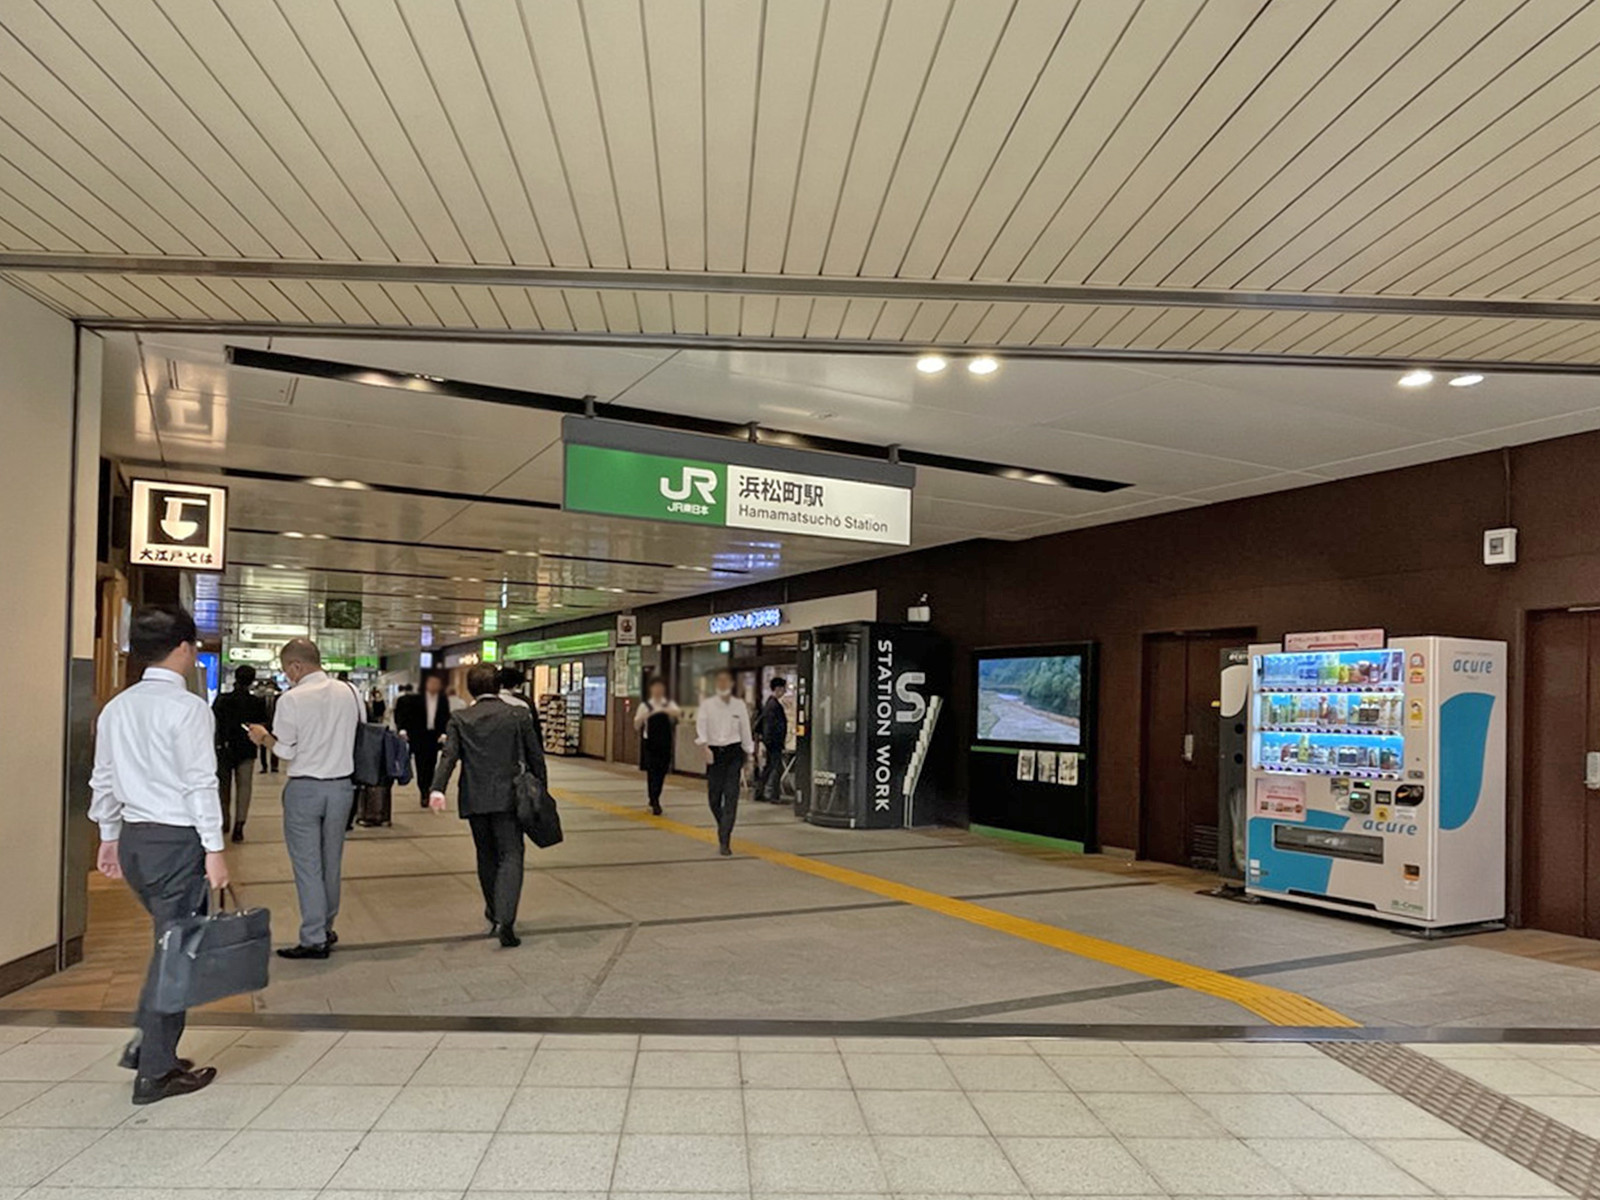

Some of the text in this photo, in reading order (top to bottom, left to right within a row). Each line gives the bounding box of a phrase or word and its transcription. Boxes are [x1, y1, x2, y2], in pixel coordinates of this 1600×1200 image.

[660, 466, 717, 504] JR
[738, 475, 823, 507] 浜松町駅
[667, 501, 709, 516] JR東日本
[844, 515, 888, 533] Station
[1452, 658, 1493, 675] acure
[875, 639, 893, 812] STATION WORK
[1362, 819, 1418, 836] acure
